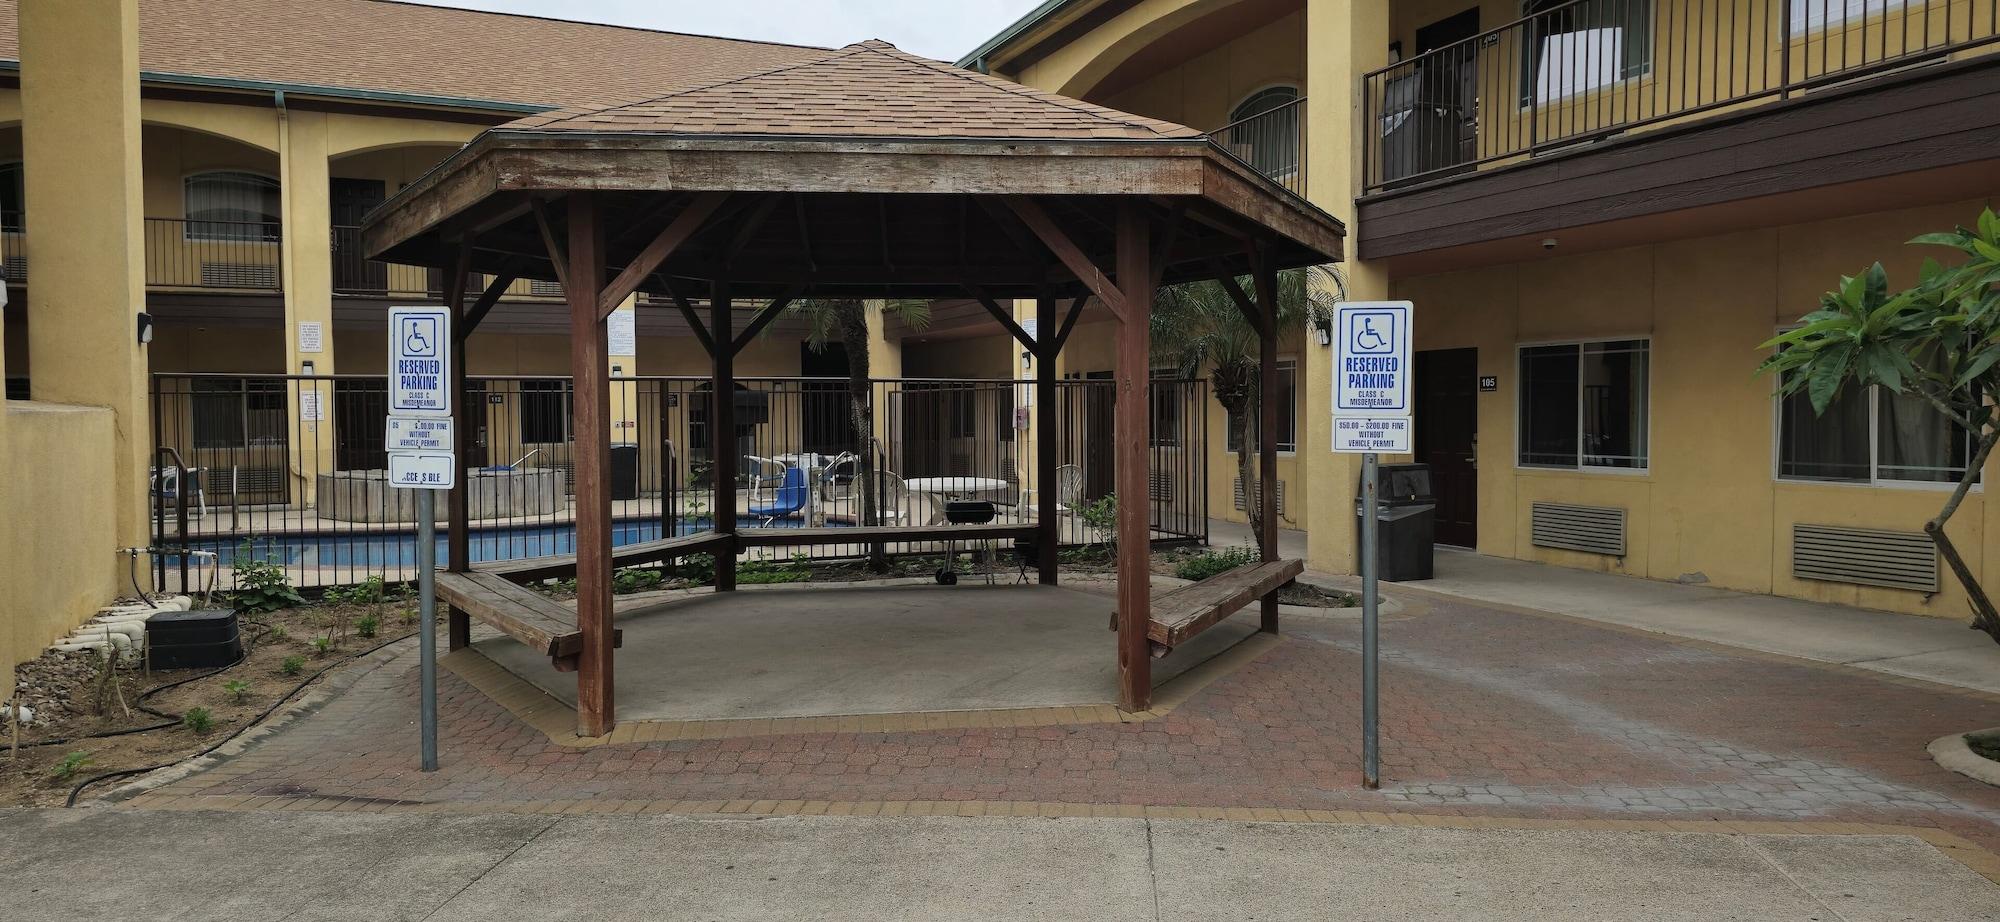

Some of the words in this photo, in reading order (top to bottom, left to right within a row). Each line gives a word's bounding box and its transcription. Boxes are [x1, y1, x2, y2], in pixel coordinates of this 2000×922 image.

[399, 360, 440, 374] RESERVED
[1346, 357, 1398, 372] RESERVED
[401, 375, 438, 390] PARKING
[1348, 373, 1395, 389] PARKING
[1482, 378, 1495, 387] 105
[409, 391, 424, 399] CLASS
[426, 391, 430, 399] C
[1358, 390, 1377, 398] CLASS
[1380, 390, 1385, 398] C
[402, 399, 437, 407] MISDEMEANOR
[1350, 398, 1393, 406] MISDEMEANOR
[436, 422, 448, 430] FINE
[1339, 421, 1359, 430] $50.00
[1365, 422, 1390, 430] $200.00
[1391, 422, 1405, 430] FINE
[409, 430, 430, 438] WITHOUT
[1359, 431, 1385, 439] WITHOUT
[400, 439, 419, 447] VEHICLE
[420, 439, 440, 447] PERMIT
[1348, 439, 1372, 447] VEHICLE
[1373, 440, 1395, 448] PERMIT
